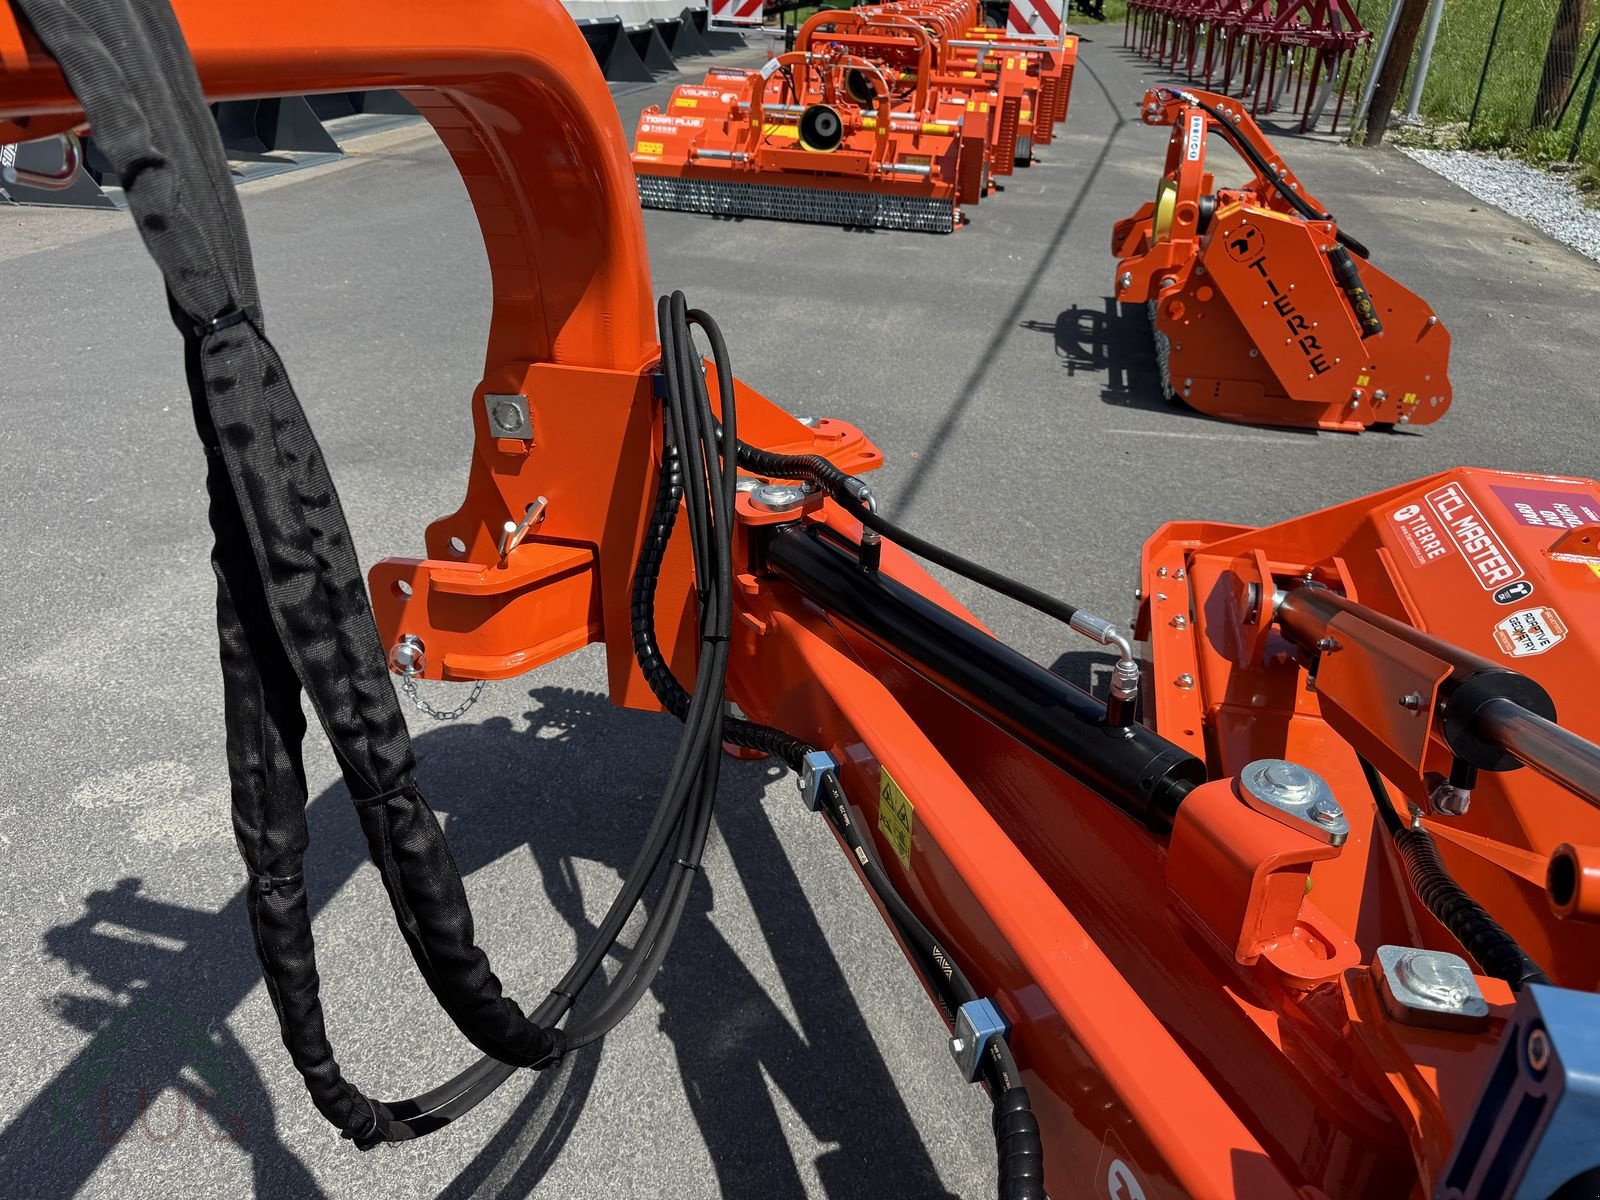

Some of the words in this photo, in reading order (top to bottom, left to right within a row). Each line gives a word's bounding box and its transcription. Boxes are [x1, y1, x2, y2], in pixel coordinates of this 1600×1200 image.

[675, 118, 701, 127] PLUS
[1248, 256, 1331, 375] TIERRE
[1514, 503, 1546, 526] HARD
[1539, 510, 1567, 528] AND
[1408, 514, 1447, 559] TIERRE
[1433, 487, 1465, 521] TCL
[1451, 515, 1514, 585] MASTER
[1508, 616, 1537, 652] GEOMETRY
[1523, 612, 1551, 647] ADAPTIVE
